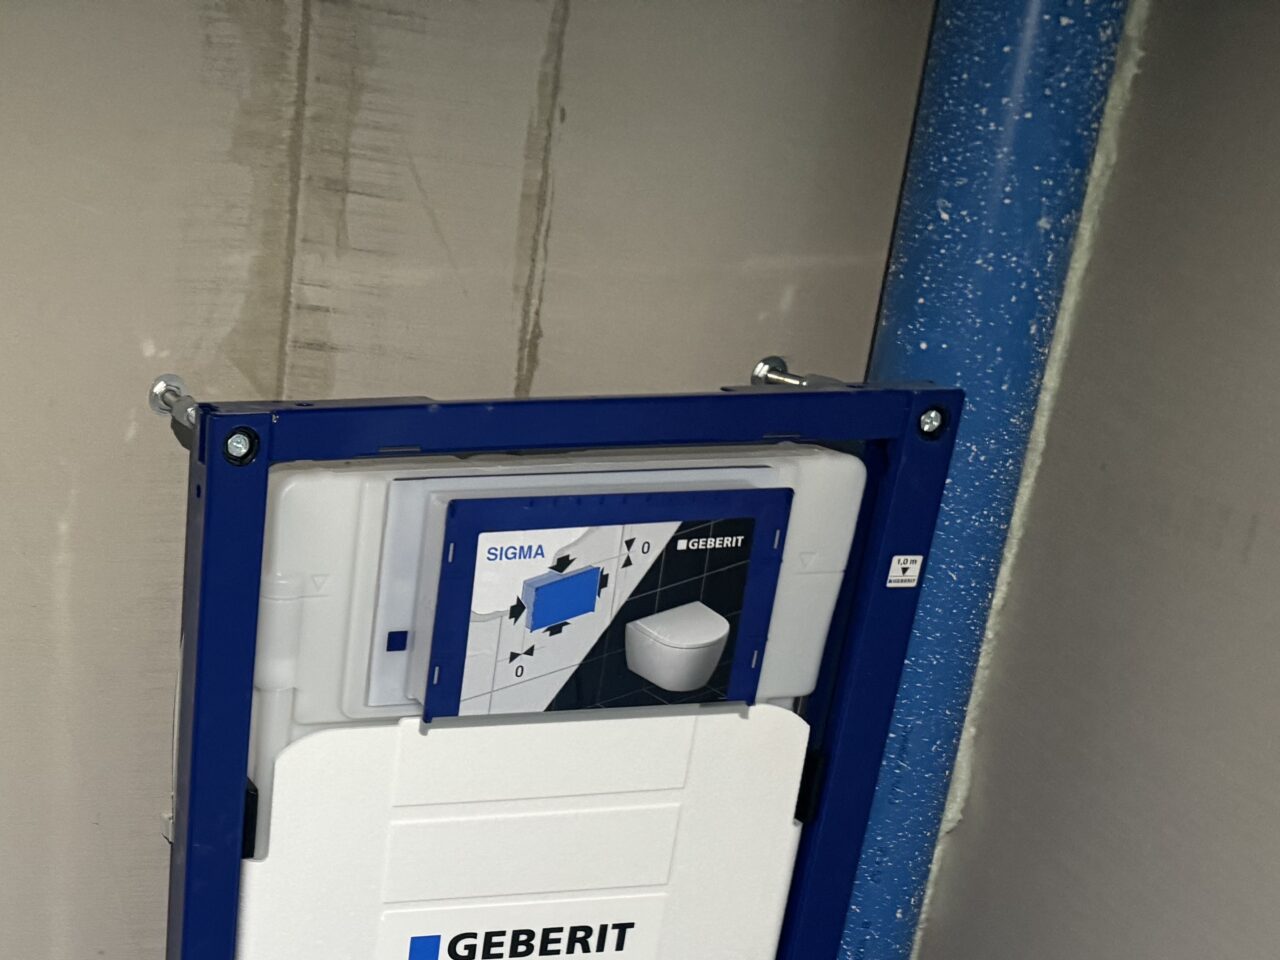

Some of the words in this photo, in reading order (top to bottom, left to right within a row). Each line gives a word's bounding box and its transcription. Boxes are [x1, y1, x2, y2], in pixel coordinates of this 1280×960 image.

[641, 541, 651, 555] 0
[687, 535, 745, 551] GEBERIT
[486, 544, 546, 562] SIGMA
[515, 665, 525, 678] 0
